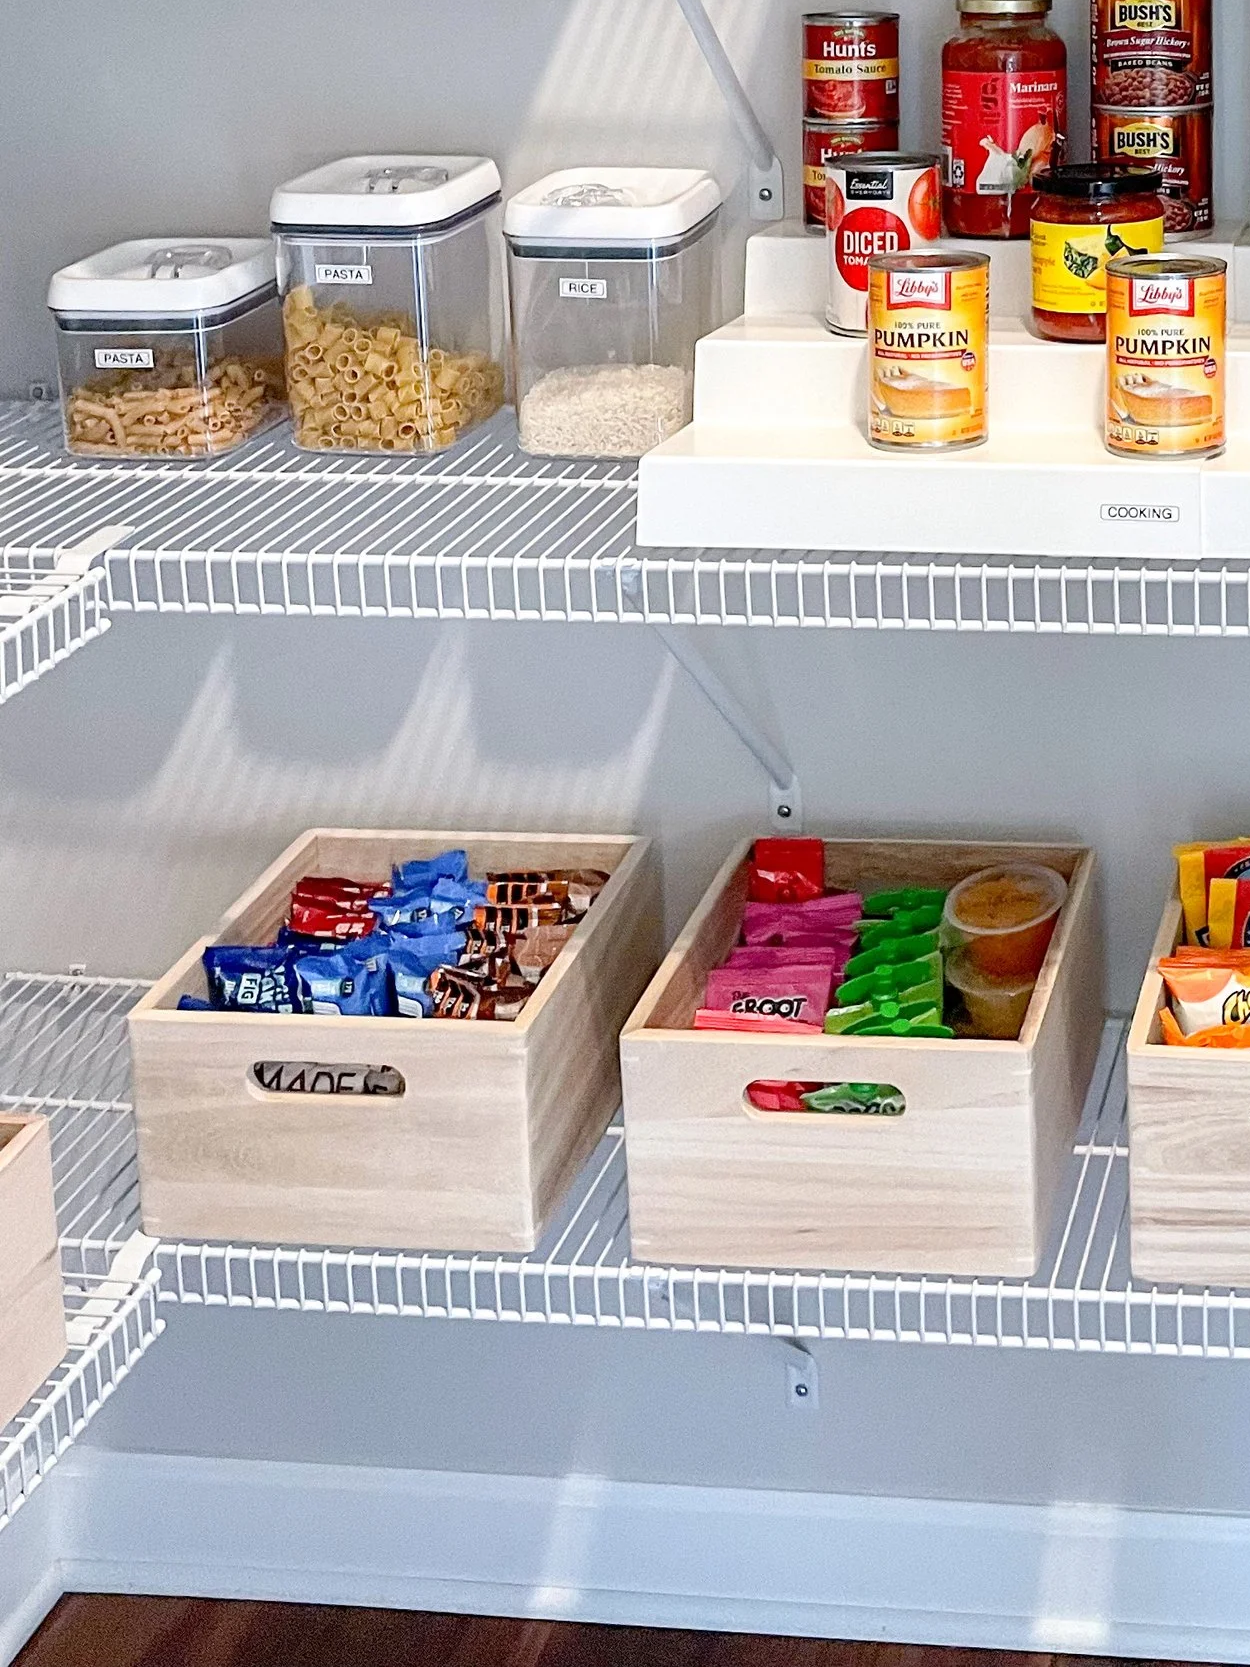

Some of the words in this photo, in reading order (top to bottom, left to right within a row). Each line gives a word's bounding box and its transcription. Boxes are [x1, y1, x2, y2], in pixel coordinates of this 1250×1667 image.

[1119, 3, 1173, 23] BUSH'S
[1129, 35, 1156, 48] Sugar
[1155, 36, 1188, 50] Hickory
[814, 64, 853, 75] Tomato
[856, 63, 887, 74] Sauce
[1145, 59, 1174, 67] BEANS
[1009, 80, 1058, 94] Marinara
[1117, 131, 1170, 150] BUSH'S
[849, 177, 888, 191] Essential
[843, 230, 899, 254] DICED
[324, 269, 364, 280] PASTA
[569, 282, 597, 294] RICE
[895, 277, 939, 297] Libby's
[1138, 284, 1183, 304] Libby's
[916, 321, 941, 331] PURE
[1137, 328, 1158, 337] 100%
[1160, 328, 1185, 337] PURE
[874, 328, 969, 349] PUMPKIN
[1115, 336, 1211, 356] PUMPKIN
[103, 353, 145, 364] PASTA
[1108, 506, 1172, 520] COOKING
[241, 978, 258, 1000] FIG
